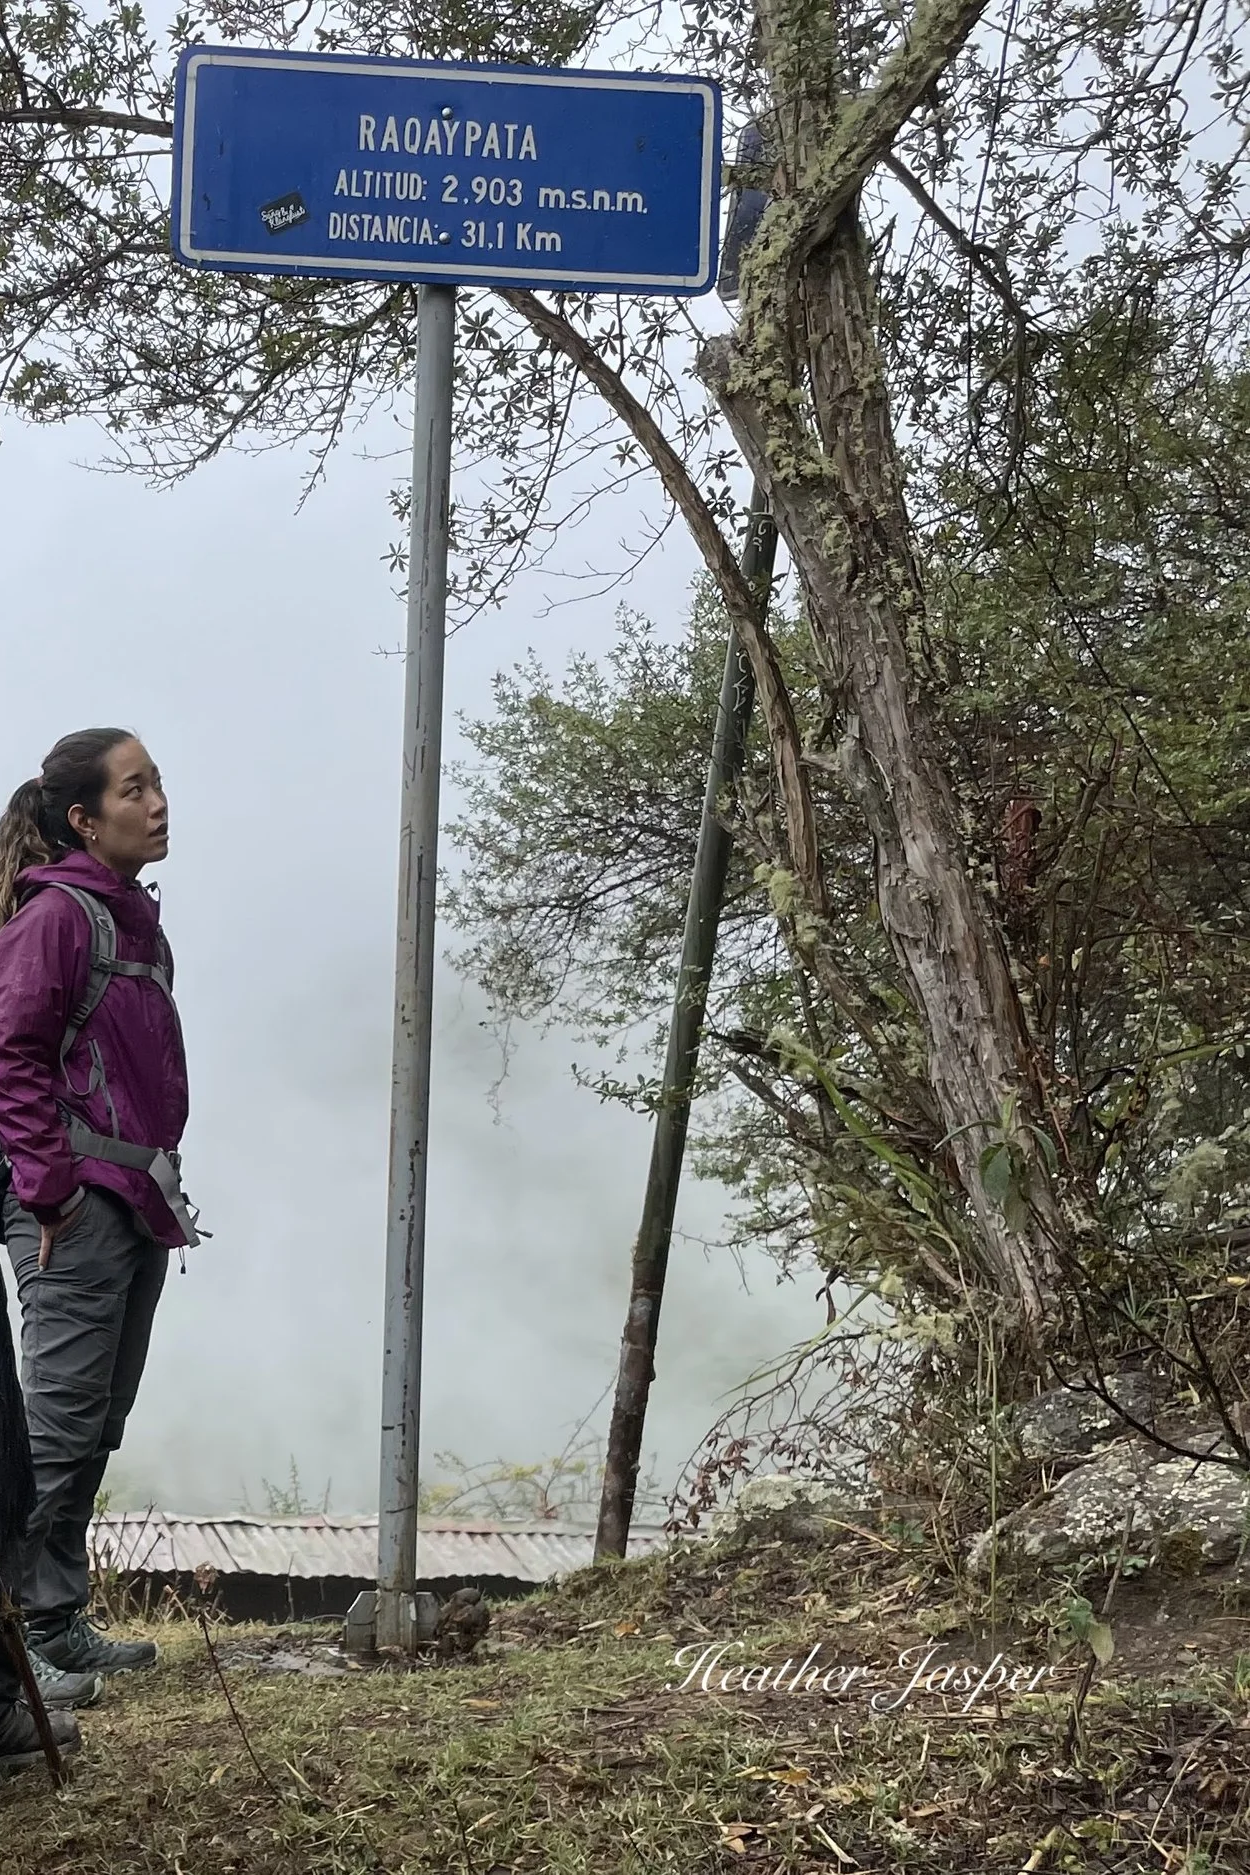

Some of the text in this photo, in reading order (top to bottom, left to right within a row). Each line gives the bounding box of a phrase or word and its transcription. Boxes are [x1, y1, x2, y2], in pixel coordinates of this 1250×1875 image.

[359, 114, 537, 160] RAQAYPATA
[334, 169, 648, 214] ALTITUD: 2,903 m.s.n.m.
[328, 212, 561, 252] DISTANCIA: 31,1 Km
